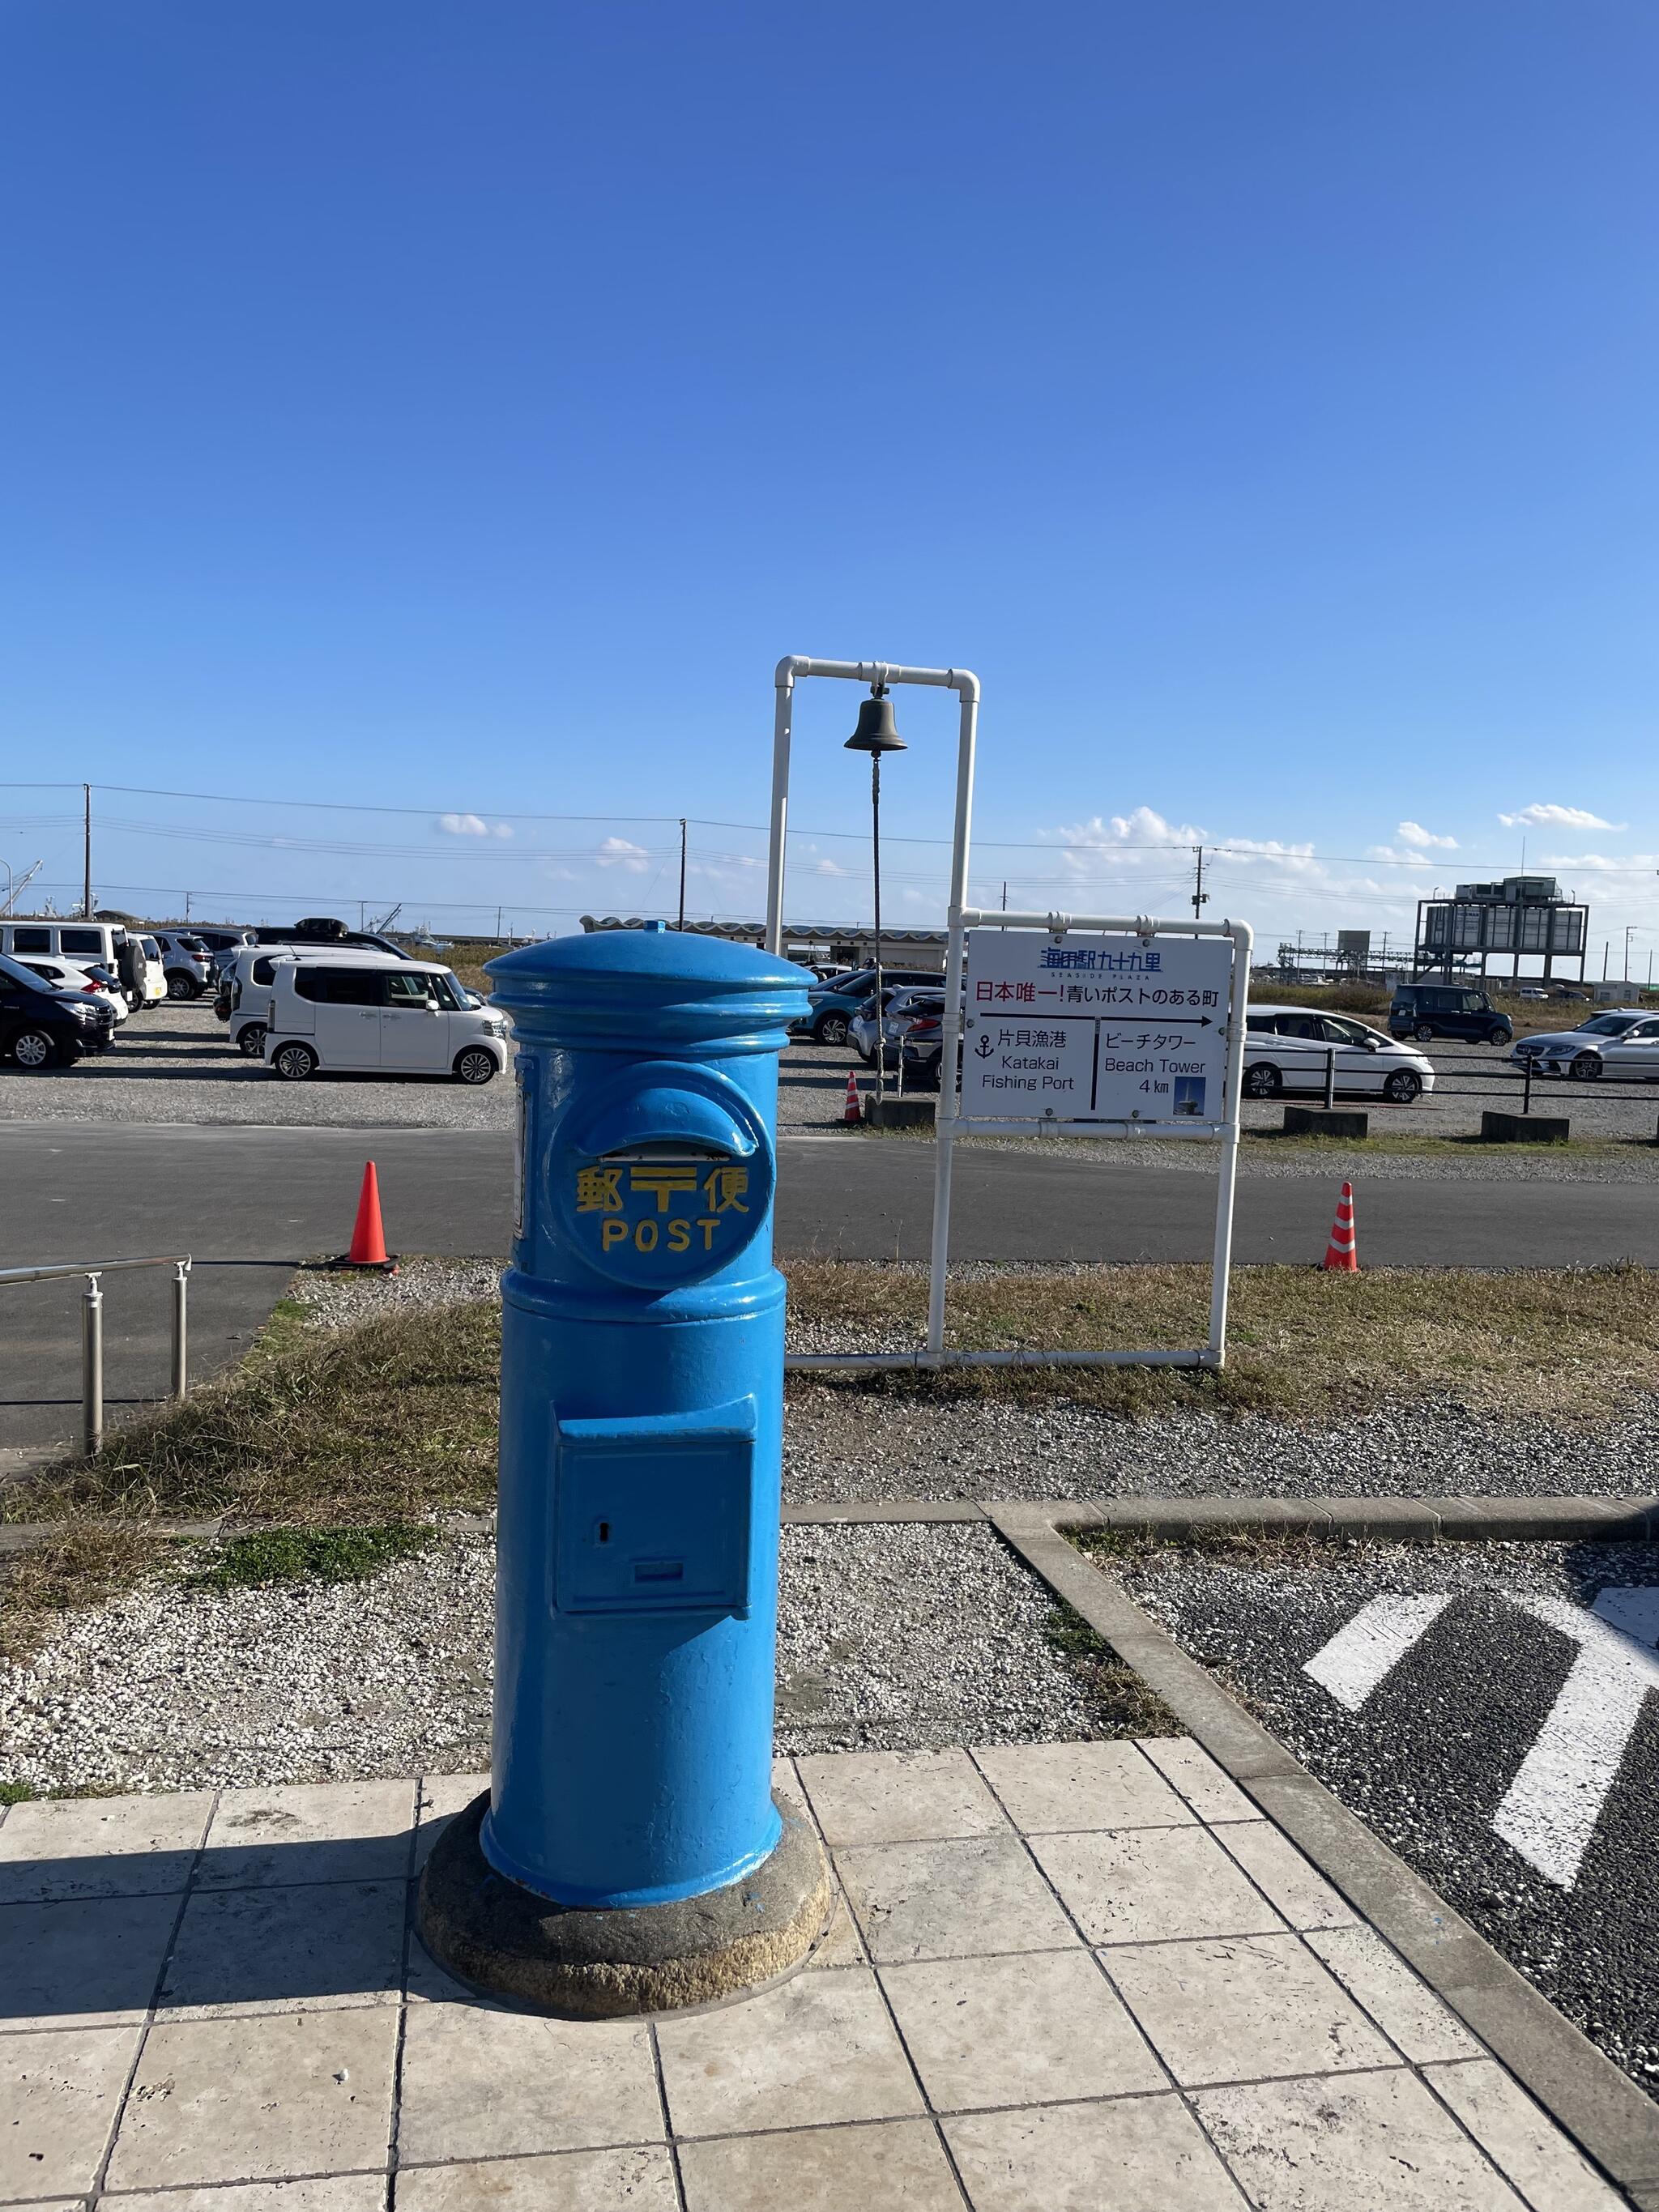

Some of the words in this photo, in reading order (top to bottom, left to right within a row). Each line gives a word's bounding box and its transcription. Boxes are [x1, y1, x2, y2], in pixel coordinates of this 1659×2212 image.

[997, 1029, 1067, 1048] 片貝漁港
[1107, 1033, 1196, 1051] ビーチタワー
[1002, 1055, 1060, 1070] Katakai
[1105, 1058, 1154, 1072] Beach
[1159, 1059, 1206, 1074] Tower
[982, 1074, 1037, 1091] Fishing
[1042, 1076, 1075, 1090] Port
[602, 1218, 721, 1252] POST
